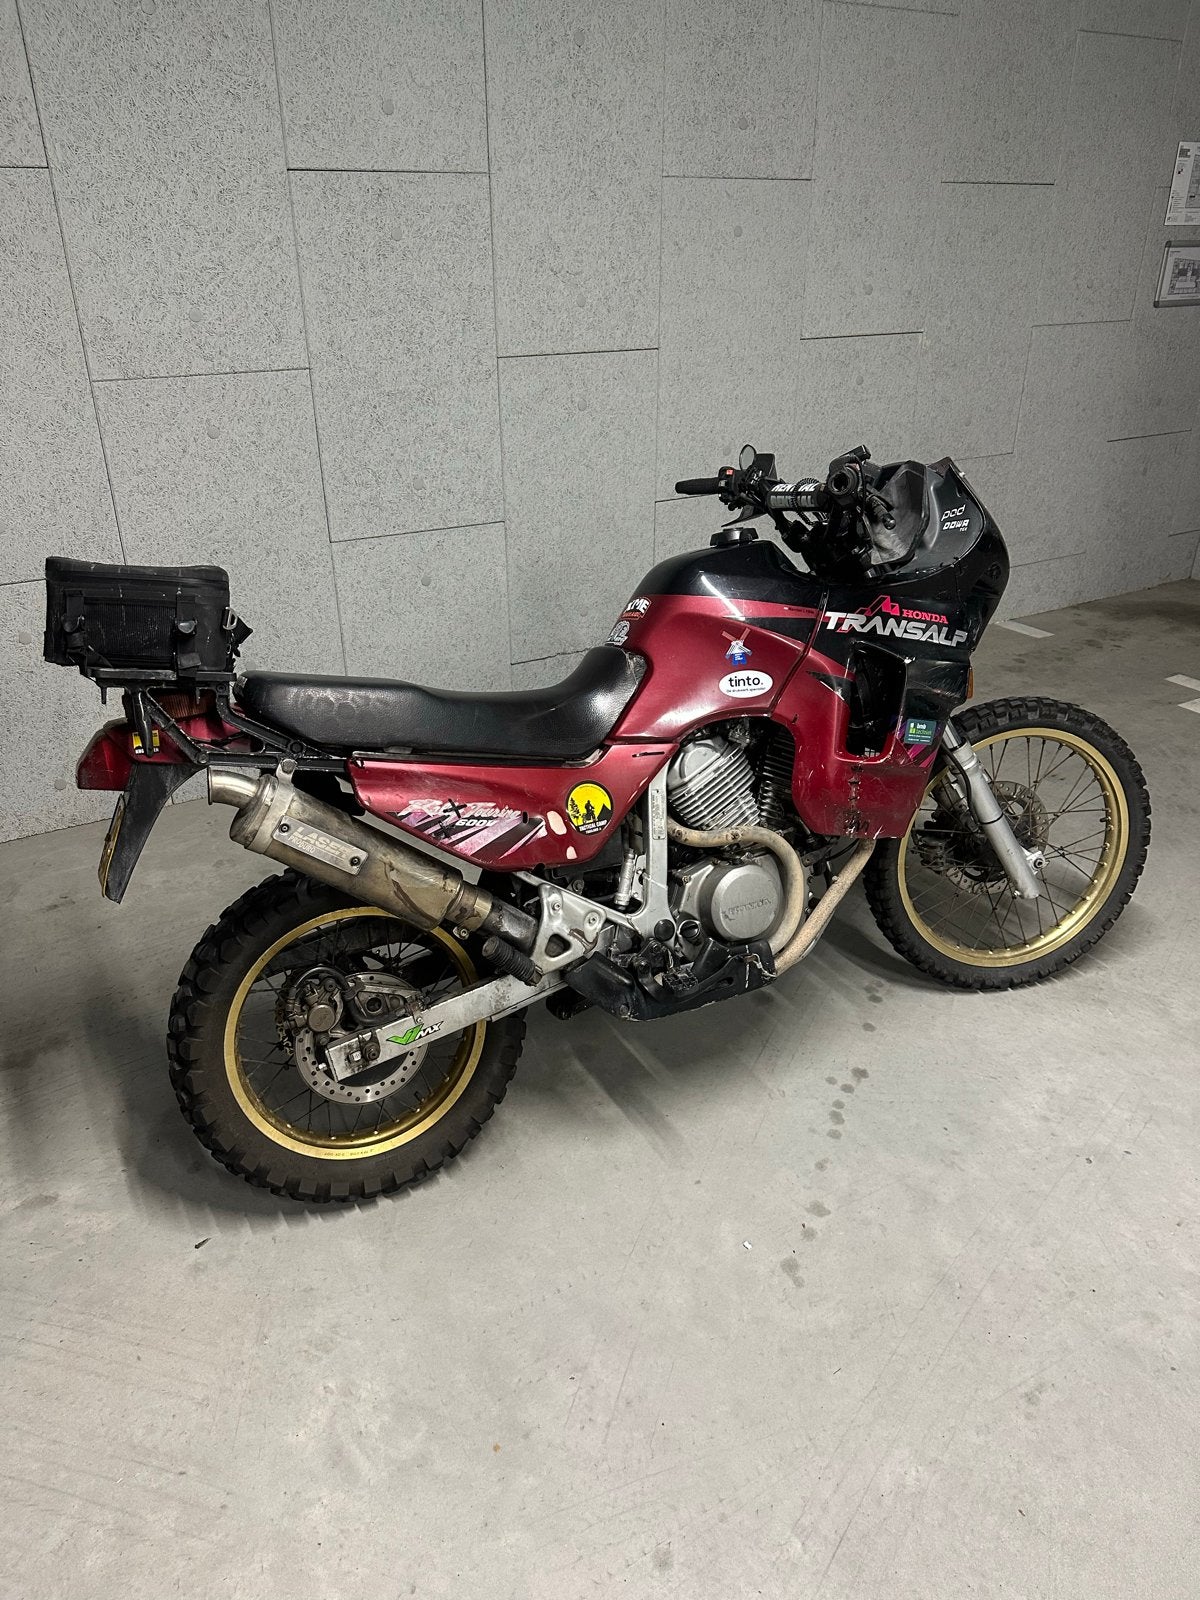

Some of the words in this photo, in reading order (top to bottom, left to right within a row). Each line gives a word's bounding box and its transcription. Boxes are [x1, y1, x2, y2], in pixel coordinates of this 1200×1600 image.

[824, 610, 968, 647] TRANSALP
[902, 608, 949, 625] HONDA
[728, 676, 763, 687] tinto.
[291, 826, 353, 859] LASER
